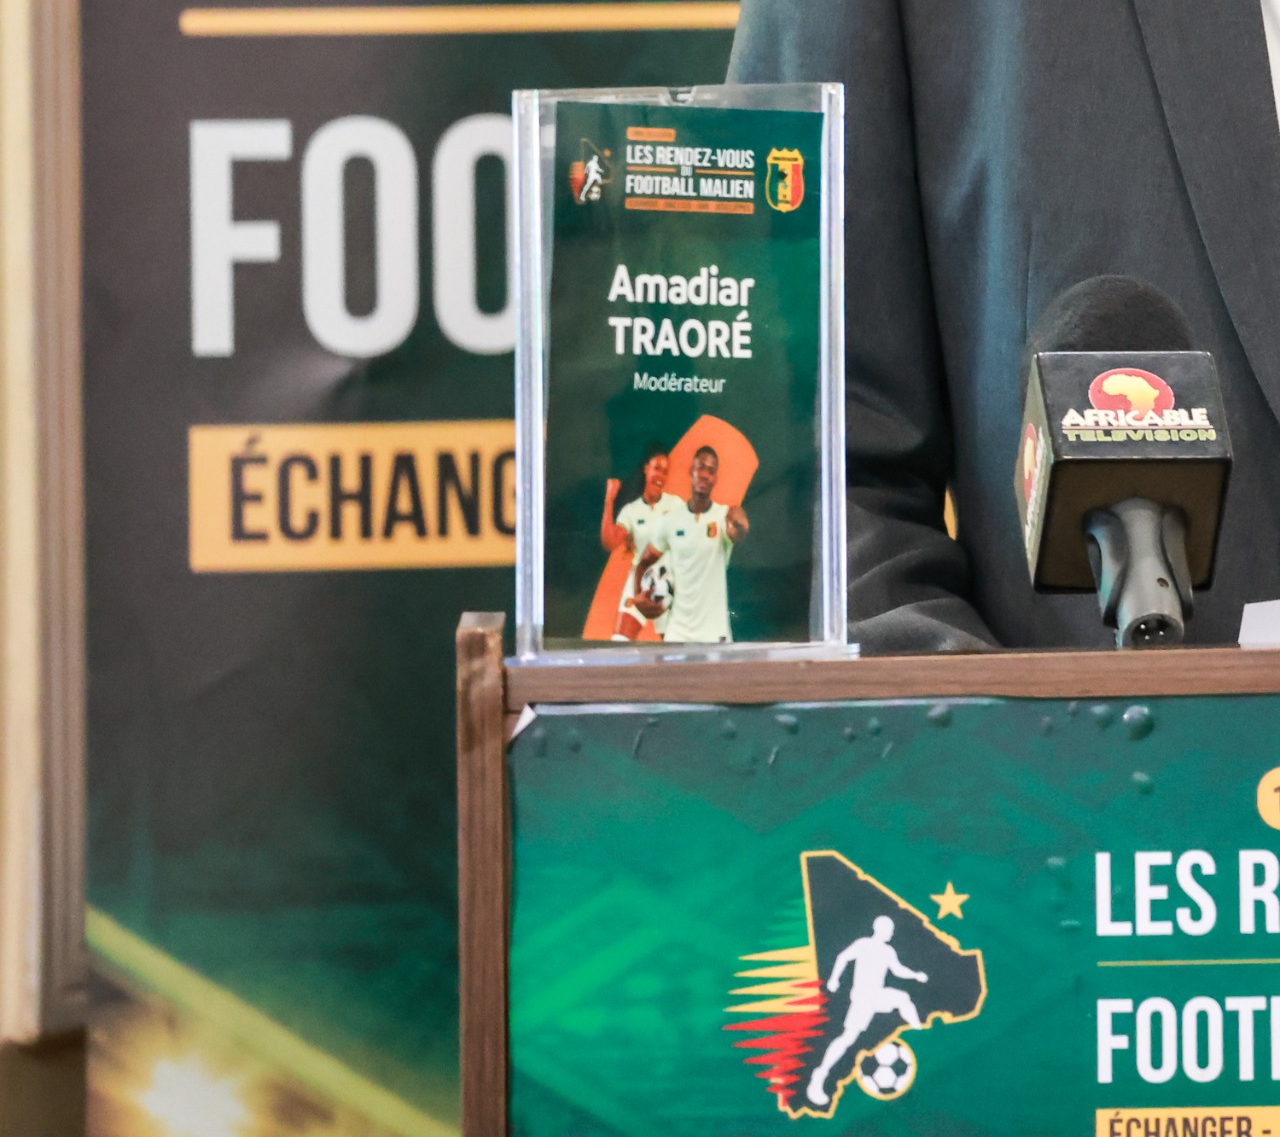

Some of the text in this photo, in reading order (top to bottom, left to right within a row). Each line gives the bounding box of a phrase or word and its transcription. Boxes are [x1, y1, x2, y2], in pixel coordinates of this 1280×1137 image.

[626, 144, 755, 168] LES RENDEZ-VOUS
[625, 174, 697, 196] FOOTBALL
[700, 178, 755, 199] MALIEN
[608, 264, 755, 306] Amadiar
[608, 310, 752, 358] TRAORÉ
[633, 371, 726, 393] Modérateur
[1061, 408, 1210, 427] AFRICABLE
[1062, 429, 1216, 442] TELEVISION
[1095, 850, 1218, 937] LES
[1108, 1110, 1253, 1137] ÉCHANGER
